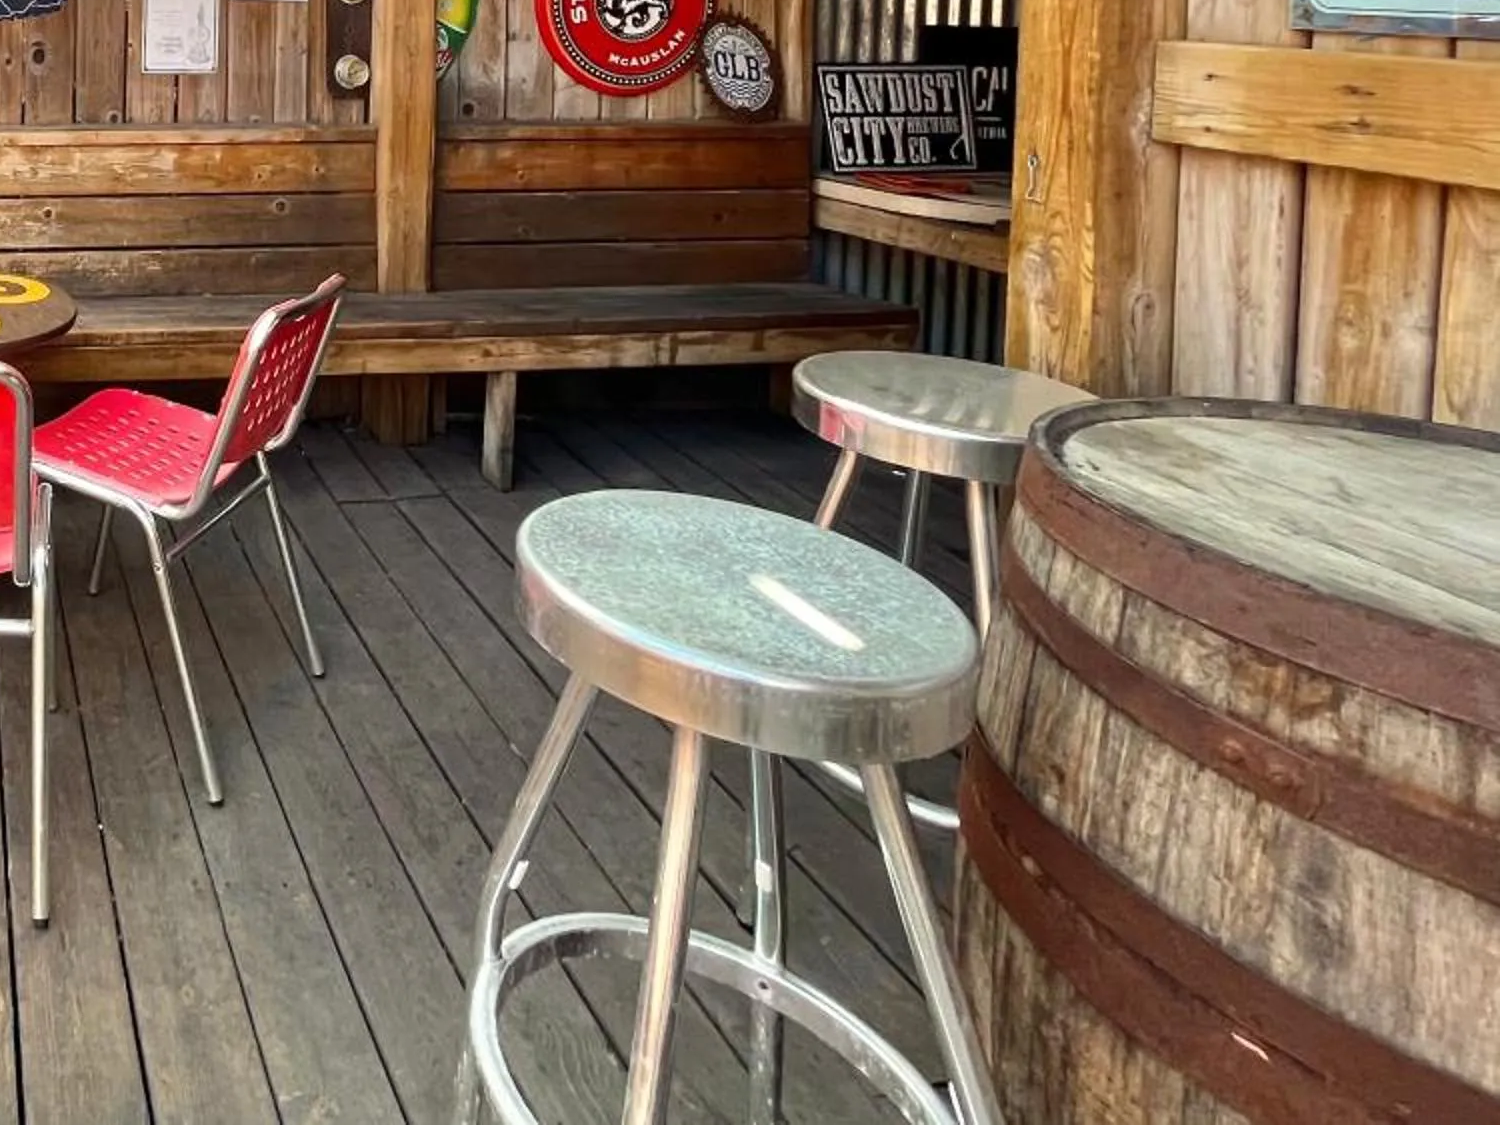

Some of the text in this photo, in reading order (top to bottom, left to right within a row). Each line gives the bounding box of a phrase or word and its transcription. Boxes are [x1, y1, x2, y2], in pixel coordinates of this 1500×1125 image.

[713, 50, 761, 82] GLB
[824, 72, 955, 114] SAWDUST
[831, 116, 907, 165] CITY
[908, 136, 937, 164] CO.
